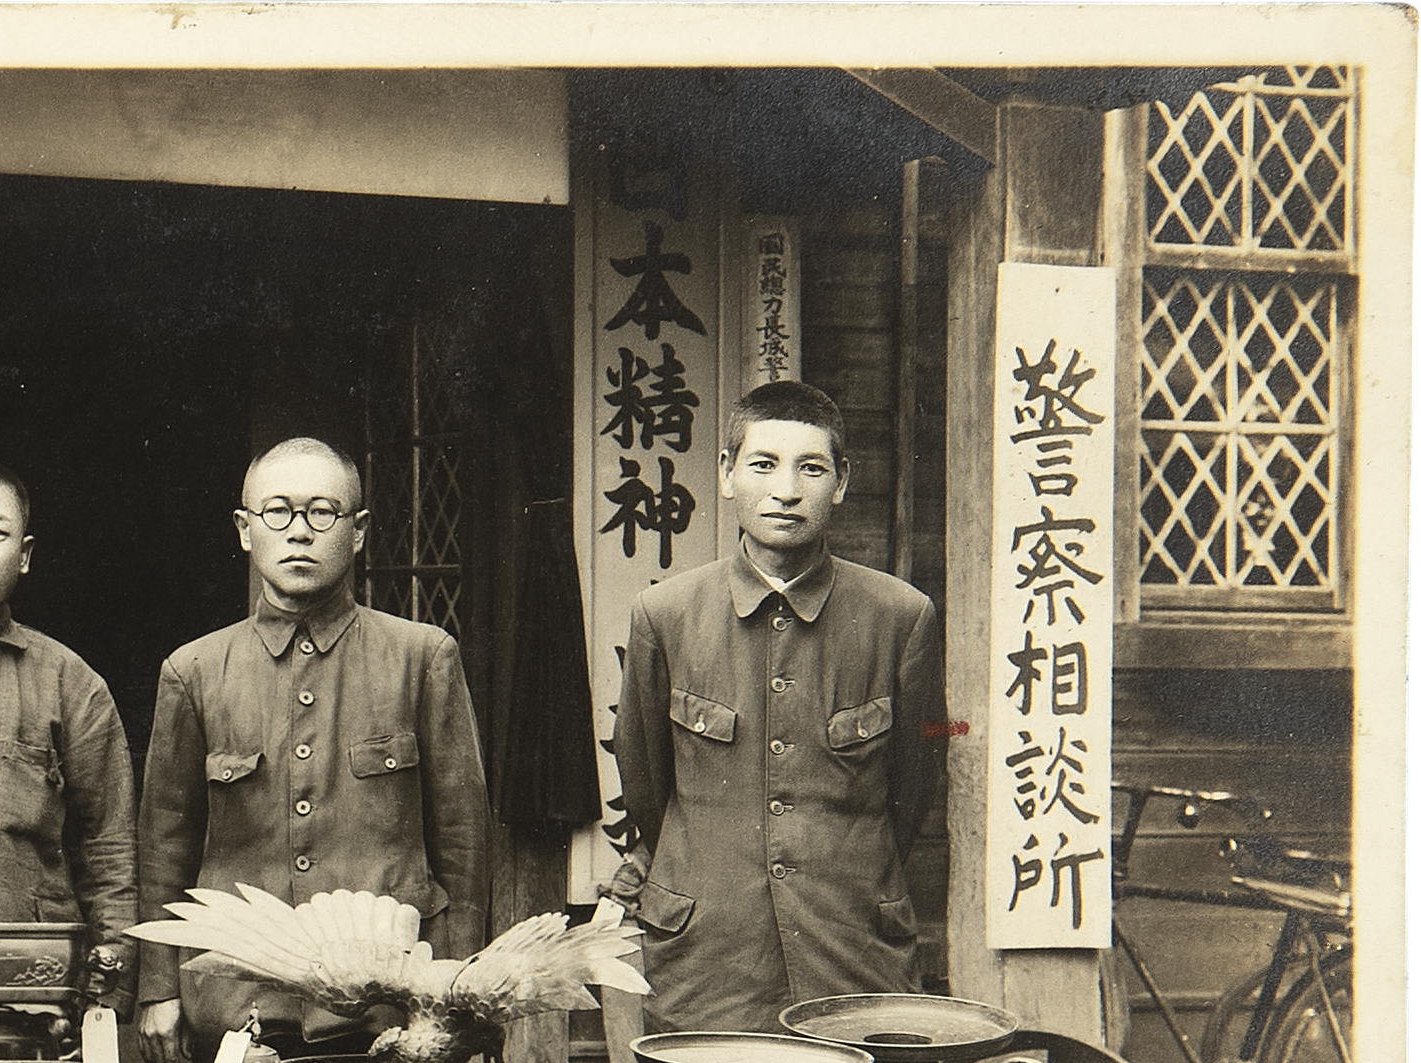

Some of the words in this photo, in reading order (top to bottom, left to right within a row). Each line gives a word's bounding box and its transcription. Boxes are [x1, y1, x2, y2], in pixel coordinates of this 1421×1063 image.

[598, 128, 708, 858] 日本精神
[1005, 338, 1105, 931] 警察相談所
